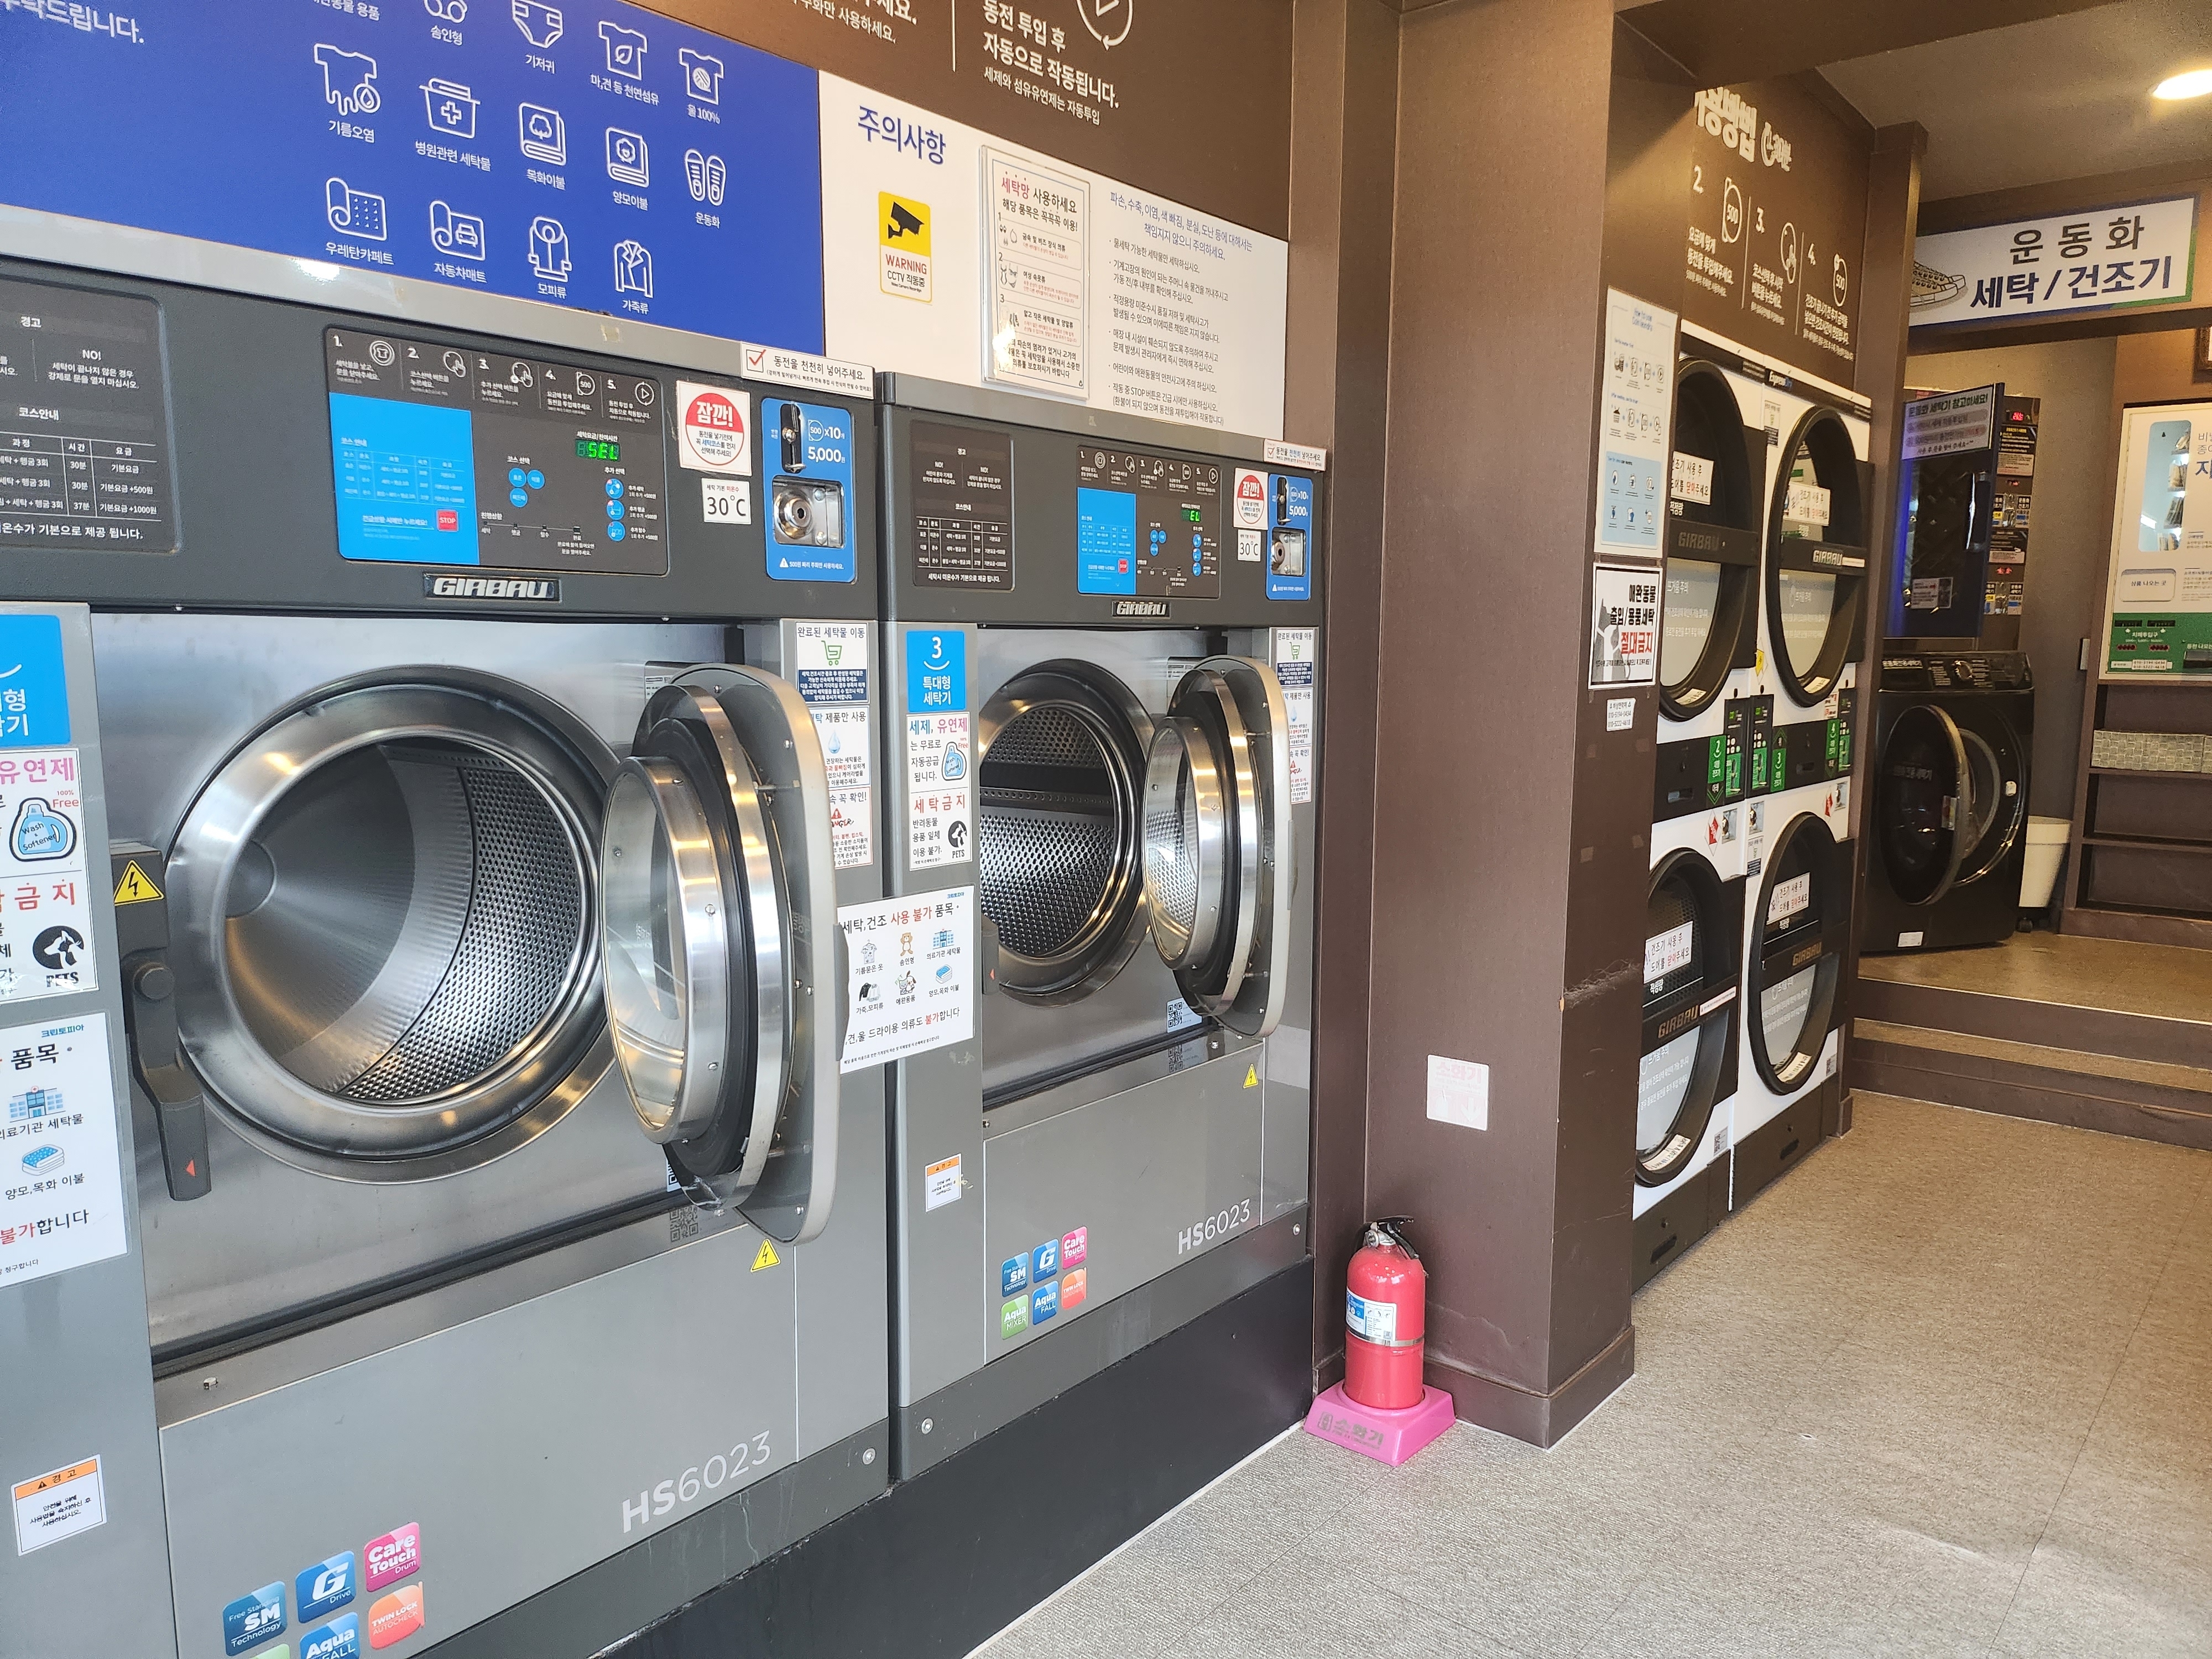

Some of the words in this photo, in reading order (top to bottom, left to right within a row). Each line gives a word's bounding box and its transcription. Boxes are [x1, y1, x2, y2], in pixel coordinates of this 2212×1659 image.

[431, 25, 462, 45] 솜인형
[983, 0, 1013, 32] 동전
[1018, 12, 1046, 47] 투입
[1051, 28, 1066, 53] 후
[525, 54, 555, 74] 기저귀
[983, 32, 1044, 77] 자동으로
[1047, 58, 1119, 108] 작동됩니다.
[984, 66, 1011, 90] 세제와
[1014, 77, 1066, 112] 섬유유연제는
[1067, 100, 1100, 125] 자동투입
[687, 105, 697, 118] 울
[697, 106, 720, 124] 100%
[328, 121, 375, 143] 기름오염
[858, 106, 946, 165] 주의사항
[415, 141, 458, 164] 병원관련
[460, 152, 491, 171] 세탁물
[526, 169, 566, 190] 목화이불
[1693, 165, 1704, 194] 2.
[613, 191, 648, 211] 양모이불
[1001, 177, 1030, 199] 세탁망
[1034, 188, 1077, 213] 사용하세요
[695, 211, 720, 229] 운동화
[1003, 198, 1016, 212] 해당
[1019, 203, 1039, 220] 품목은
[1041, 210, 1061, 227] 꼭꼭꼭
[1063, 218, 1077, 231] 이용!
[1756, 206, 1765, 233] 3.
[1161, 210, 1168, 223] 색
[1169, 213, 1184, 230] 빠짐,
[1215, 229, 1228, 243] 등에
[1229, 234, 1253, 252] 대해서는
[1144, 223, 1171, 243] 책임지지
[1172, 232, 1191, 251] 않으니
[1193, 239, 1225, 260] 주의하세요.
[326, 242, 394, 265] 우레탄카페트
[434, 263, 487, 283] 자동차매트
[886, 253, 927, 275] WARNING
[888, 270, 905, 283] CCTV
[906, 274, 925, 288] 작동중
[538, 283, 567, 299] 모피류
[622, 299, 649, 314] 가죽류
[20, 316, 41, 328] 경고
[82, 349, 102, 361] NO!
[53, 362, 75, 372] 세탁이
[77, 364, 100, 375] 끝나지
[102, 368, 117, 377] 않은
[118, 369, 133, 378] 경우
[774, 356, 798, 370] 동전을
[801, 361, 823, 374] 천천히
[827, 365, 865, 380] 넣어주세요.
[48, 372, 71, 382] 강제로
[74, 374, 88, 384] 문을
[90, 376, 106, 386] 열지
[107, 378, 139, 389] 마십시오.
[19, 407, 59, 421] 코스안내
[697, 401, 733, 427] 잠깐!
[702, 439, 725, 448] 세탁코스를
[714, 433, 733, 441] 넣기전에
[587, 442, 618, 461] SEL
[701, 447, 715, 456] 선택해
[717, 449, 732, 457] 주세요!
[1276, 447, 1288, 457] 동전을
[1289, 450, 1301, 458] 천천히
[1302, 452, 1321, 462] 넣어주세요
[1242, 480, 1260, 497] 잠깐!
[707, 495, 746, 517] 30°C
[39, 524, 82, 536] 기본으로
[85, 526, 106, 538] 제공
[109, 528, 144, 540] 됩니다.
[1240, 541, 1259, 556] 30°C
[1813, 550, 1843, 566] GIRBAU
[433, 577, 549, 598] GIRBAU
[1629, 584, 1656, 603] 애완동물
[1117, 603, 1166, 615] GIRBAU
[1610, 606, 1655, 627] 출입/용품세탁
[798, 627, 821, 638] 완료된
[824, 628, 847, 638] 세탁물
[851, 628, 865, 639] 이동
[932, 636, 942, 659] 3
[1620, 632, 1653, 654] 절대금지
[923, 675, 951, 691] 특대형
[924, 691, 951, 706] 세탁기
[826, 712, 849, 723] 제품만
[852, 711, 866, 722] 사용
[910, 719, 933, 735] 세제,
[937, 717, 967, 733] 유연제
[0, 757, 75, 785] 유연제
[911, 756, 940, 768] 자동공급
[914, 771, 937, 782] 됩니다.
[53, 799, 79, 808] Free
[839, 794, 847, 804] 꼭
[850, 792, 867, 802] 확인!
[22, 822, 44, 834] Wash
[913, 817, 938, 829] 반려동물
[23, 833, 56, 851] Softener
[913, 832, 926, 842] 용품
[928, 831, 940, 840] 일체
[913, 848, 926, 858] 이용
[928, 846, 942, 856] 불가.
[952, 849, 964, 858] PETS
[843, 915, 887, 935] 세탁,건조
[890, 910, 910, 926] 사용
[912, 906, 932, 923] 불가
[935, 902, 953, 918] 품목
[1651, 939, 1666, 956] 건조기
[1667, 935, 1676, 948] 사용
[1678, 932, 1683, 945] 후
[1651, 958, 1665, 973] 도어를
[1667, 947, 1689, 967] 닫아주세요
[41, 1024, 85, 1037] 크린토피아
[868, 1023, 899, 1039] 드라이용
[901, 1016, 924, 1030] 의류도
[925, 1006, 960, 1025] 불가합니다
[1658, 1005, 1698, 1039] GIRBAU
[11, 1043, 59, 1071] 품목
[5, 1179, 57, 1200] 양모,목화
[61, 1173, 85, 1186] 이불
[0, 1209, 90, 1245] 불가합니다
[1178, 1198, 1250, 1255] HS6023
[1004, 1280, 1026, 1292] Technology
[1035, 1291, 1056, 1308] Aqua
[1041, 1304, 1056, 1314] FALL
[1004, 1306, 1026, 1322] Aqua
[1006, 1316, 1026, 1331] MIXER
[622, 1430, 771, 1534] HS6023
[42, 1510, 81, 1527] 사용하십시오
[368, 1534, 416, 1562] Care
[369, 1548, 416, 1575] Touch
[395, 1559, 416, 1574] Drum
[330, 1589, 351, 1604] Drive
[244, 1603, 280, 1631] SM
[372, 1612, 394, 1627] TWIN
[395, 1601, 418, 1619] LOCK
[372, 1610, 418, 1635] AUTOCHECK
[231, 1621, 281, 1647] Technology
[306, 1628, 355, 1659] Aqua
